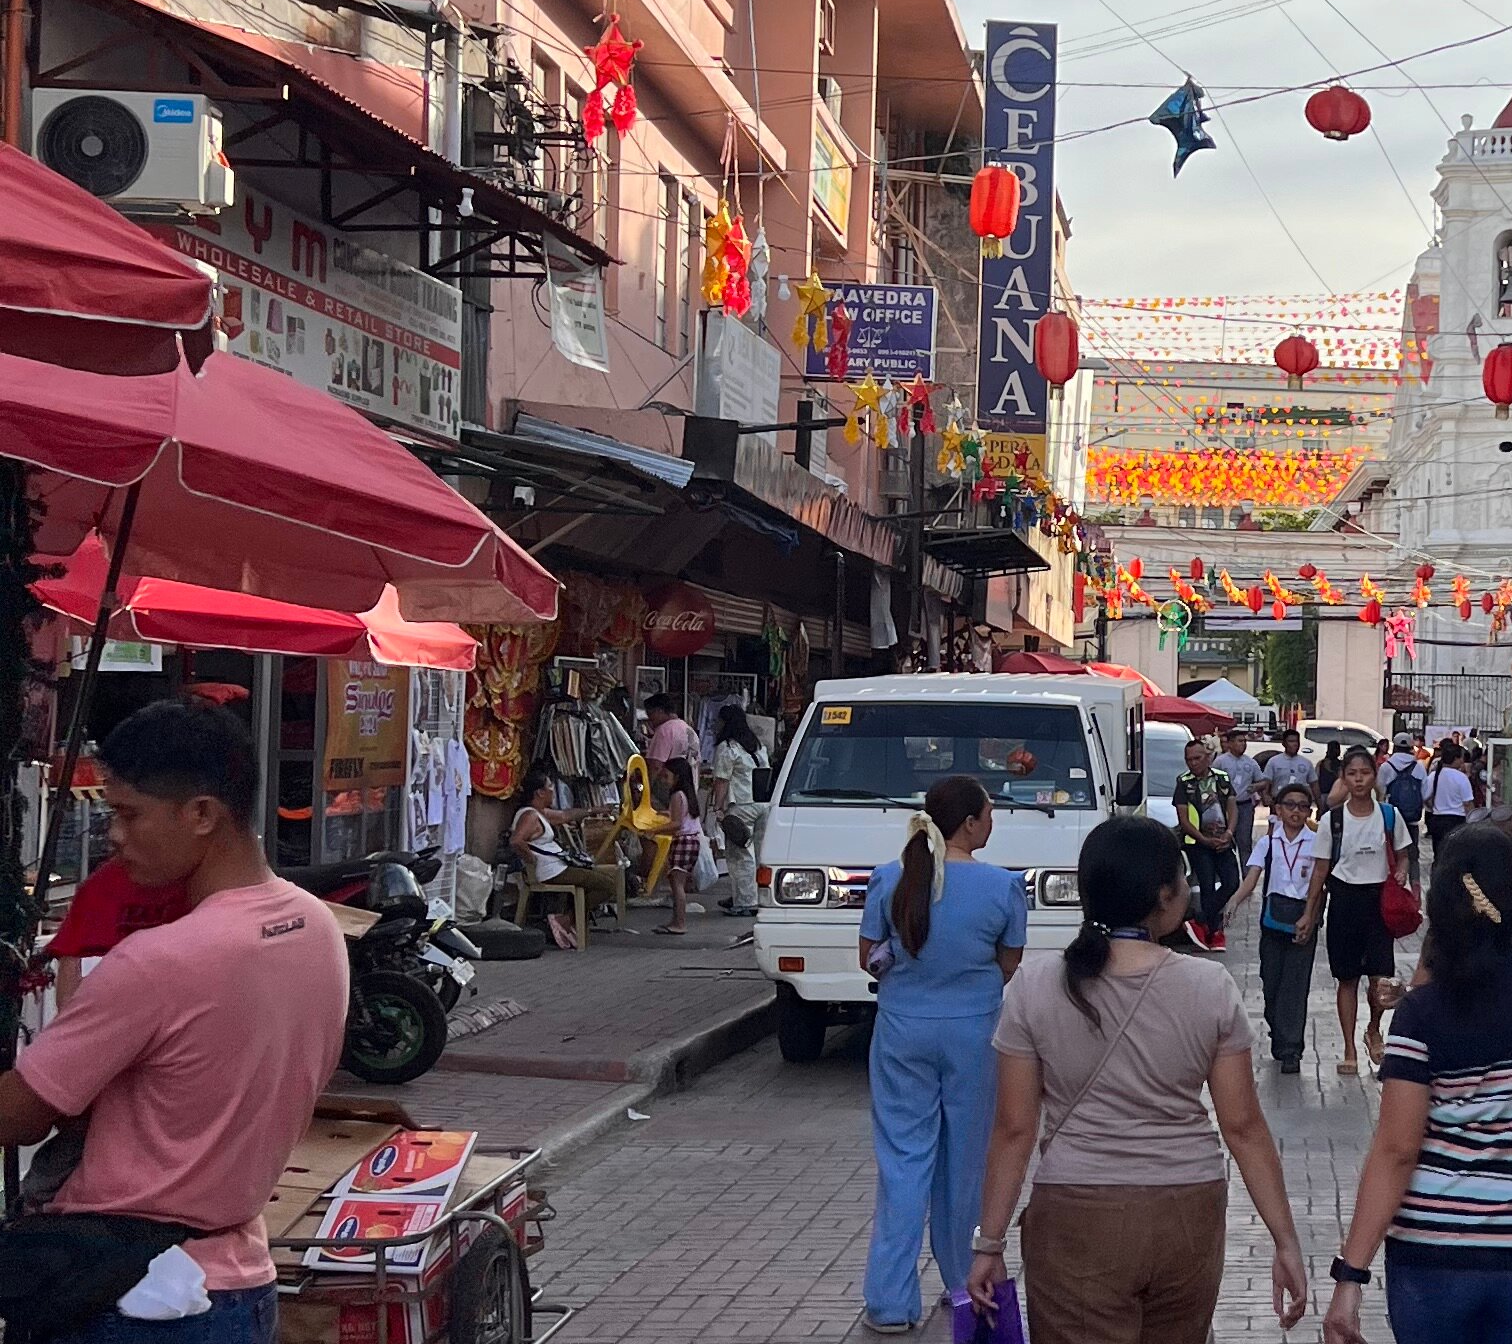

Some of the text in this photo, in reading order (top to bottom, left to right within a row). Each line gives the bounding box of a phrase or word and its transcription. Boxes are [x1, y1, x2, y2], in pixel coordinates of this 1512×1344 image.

[989, 26, 1052, 417] CEBUANA
[176, 231, 297, 299] WHOLESALE
[305, 290, 316, 306] &
[324, 297, 378, 333] RETAIL
[385, 324, 431, 355] STORE
[827, 288, 926, 306] AAVEDRA
[863, 308, 922, 324] OFFICE
[873, 358, 917, 369] PUBLIC
